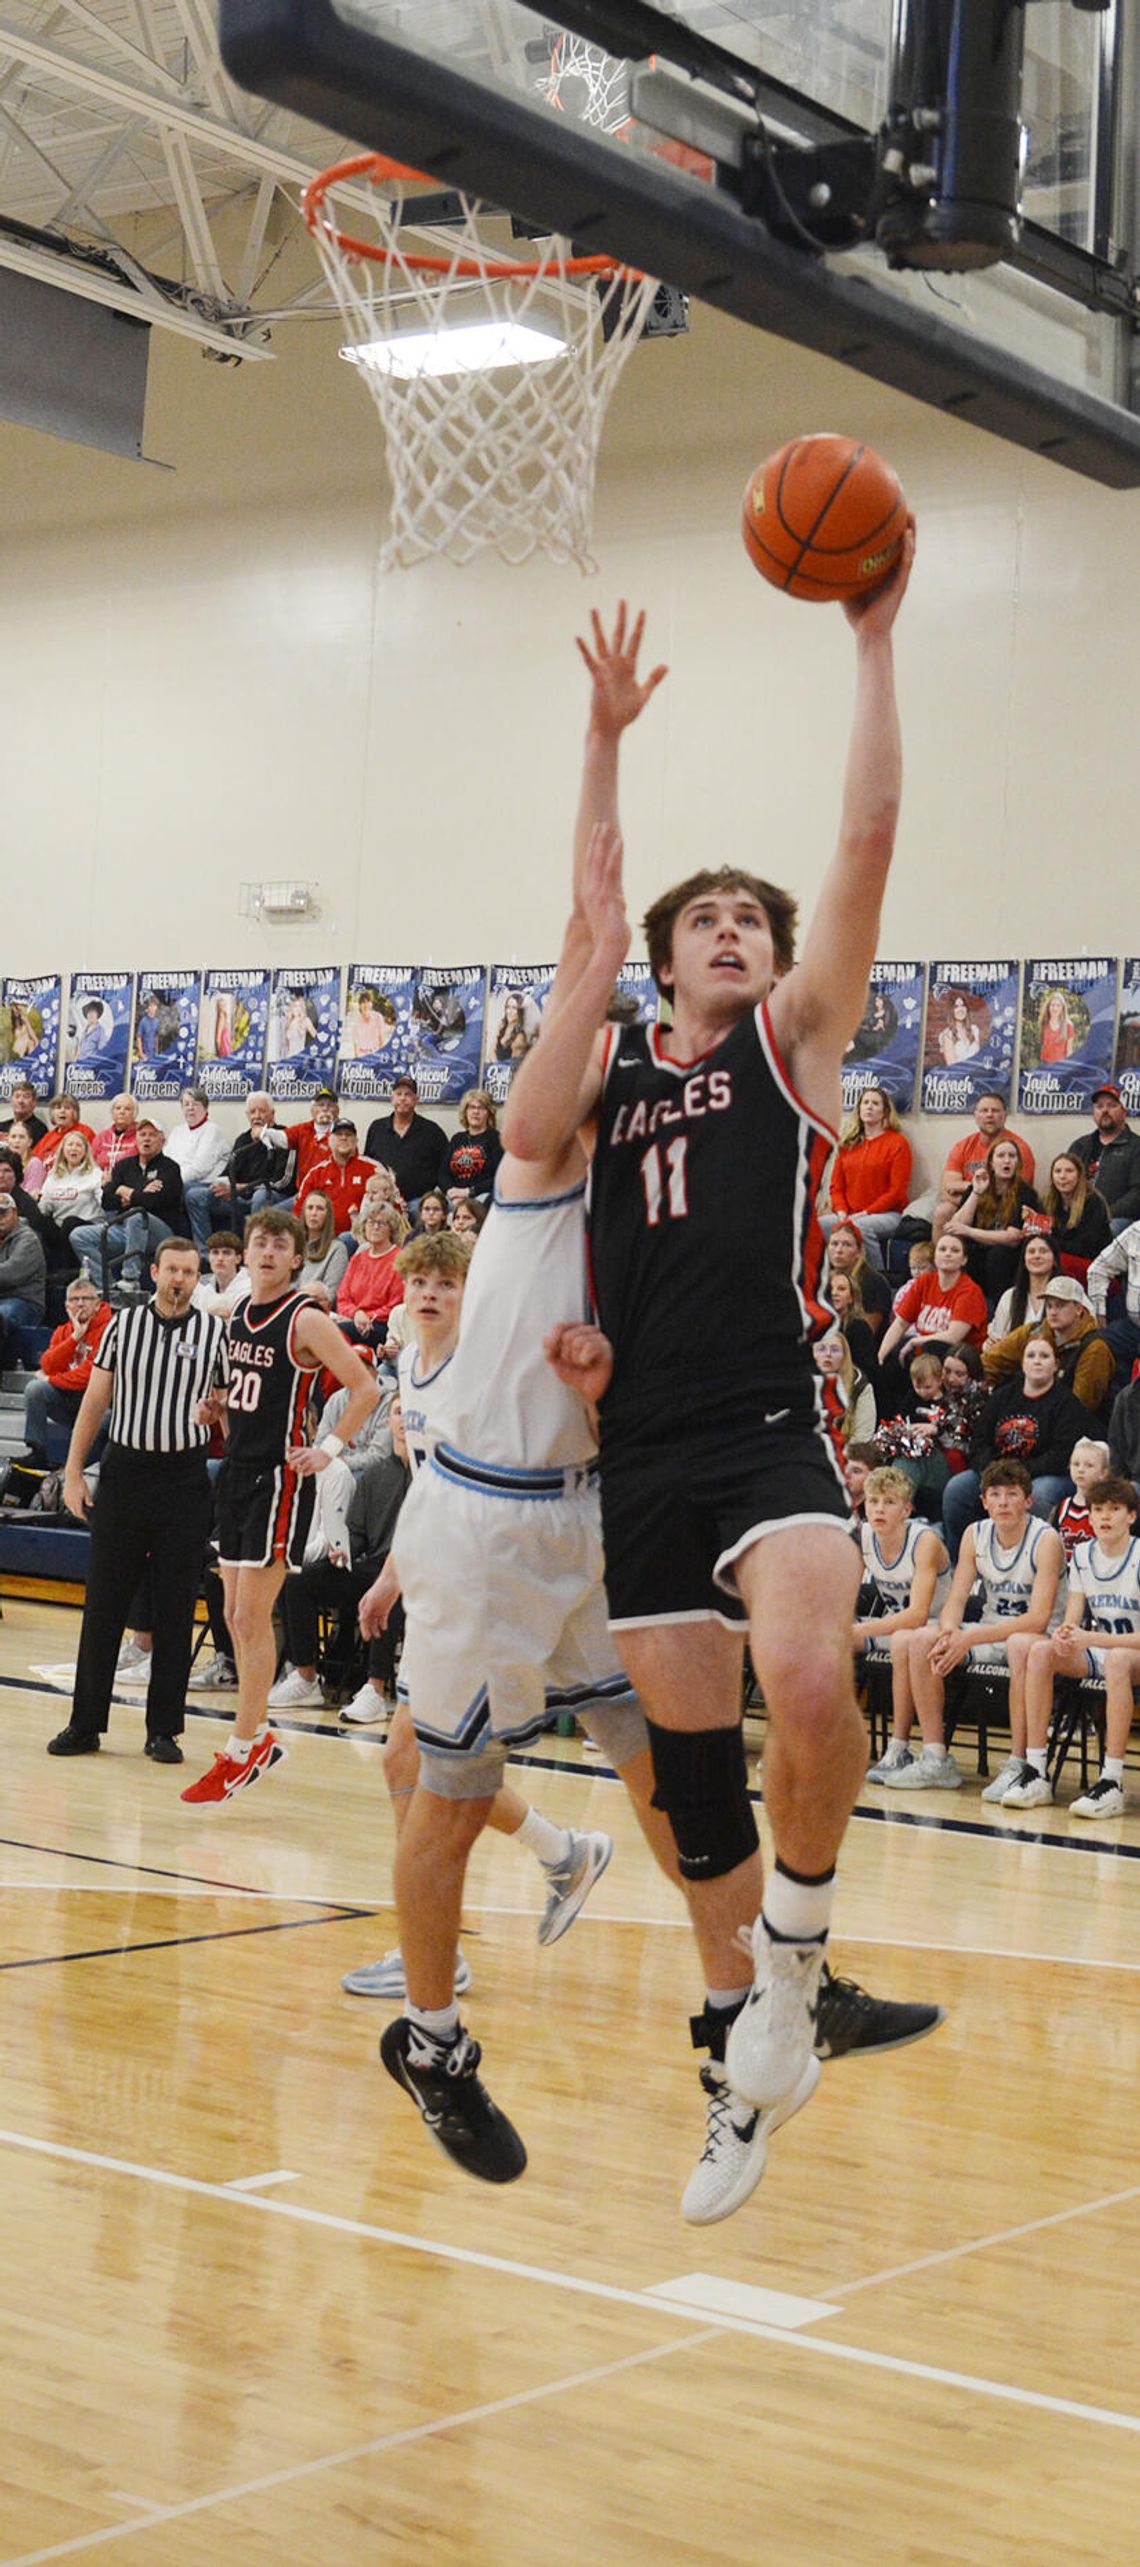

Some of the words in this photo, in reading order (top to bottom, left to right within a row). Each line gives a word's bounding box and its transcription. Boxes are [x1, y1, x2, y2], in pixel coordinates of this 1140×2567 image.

[283, 969, 334, 987] FREEMAN
[360, 966, 412, 984] FREEMAN
[943, 963, 1009, 983] FREEMAN
[1040, 961, 1108, 981] FREEMAN
[925, 1092, 967, 1109] Niles
[640, 1134, 689, 1228] 11
[228, 1339, 276, 1368] EAGLES
[227, 1367, 263, 1413] 20
